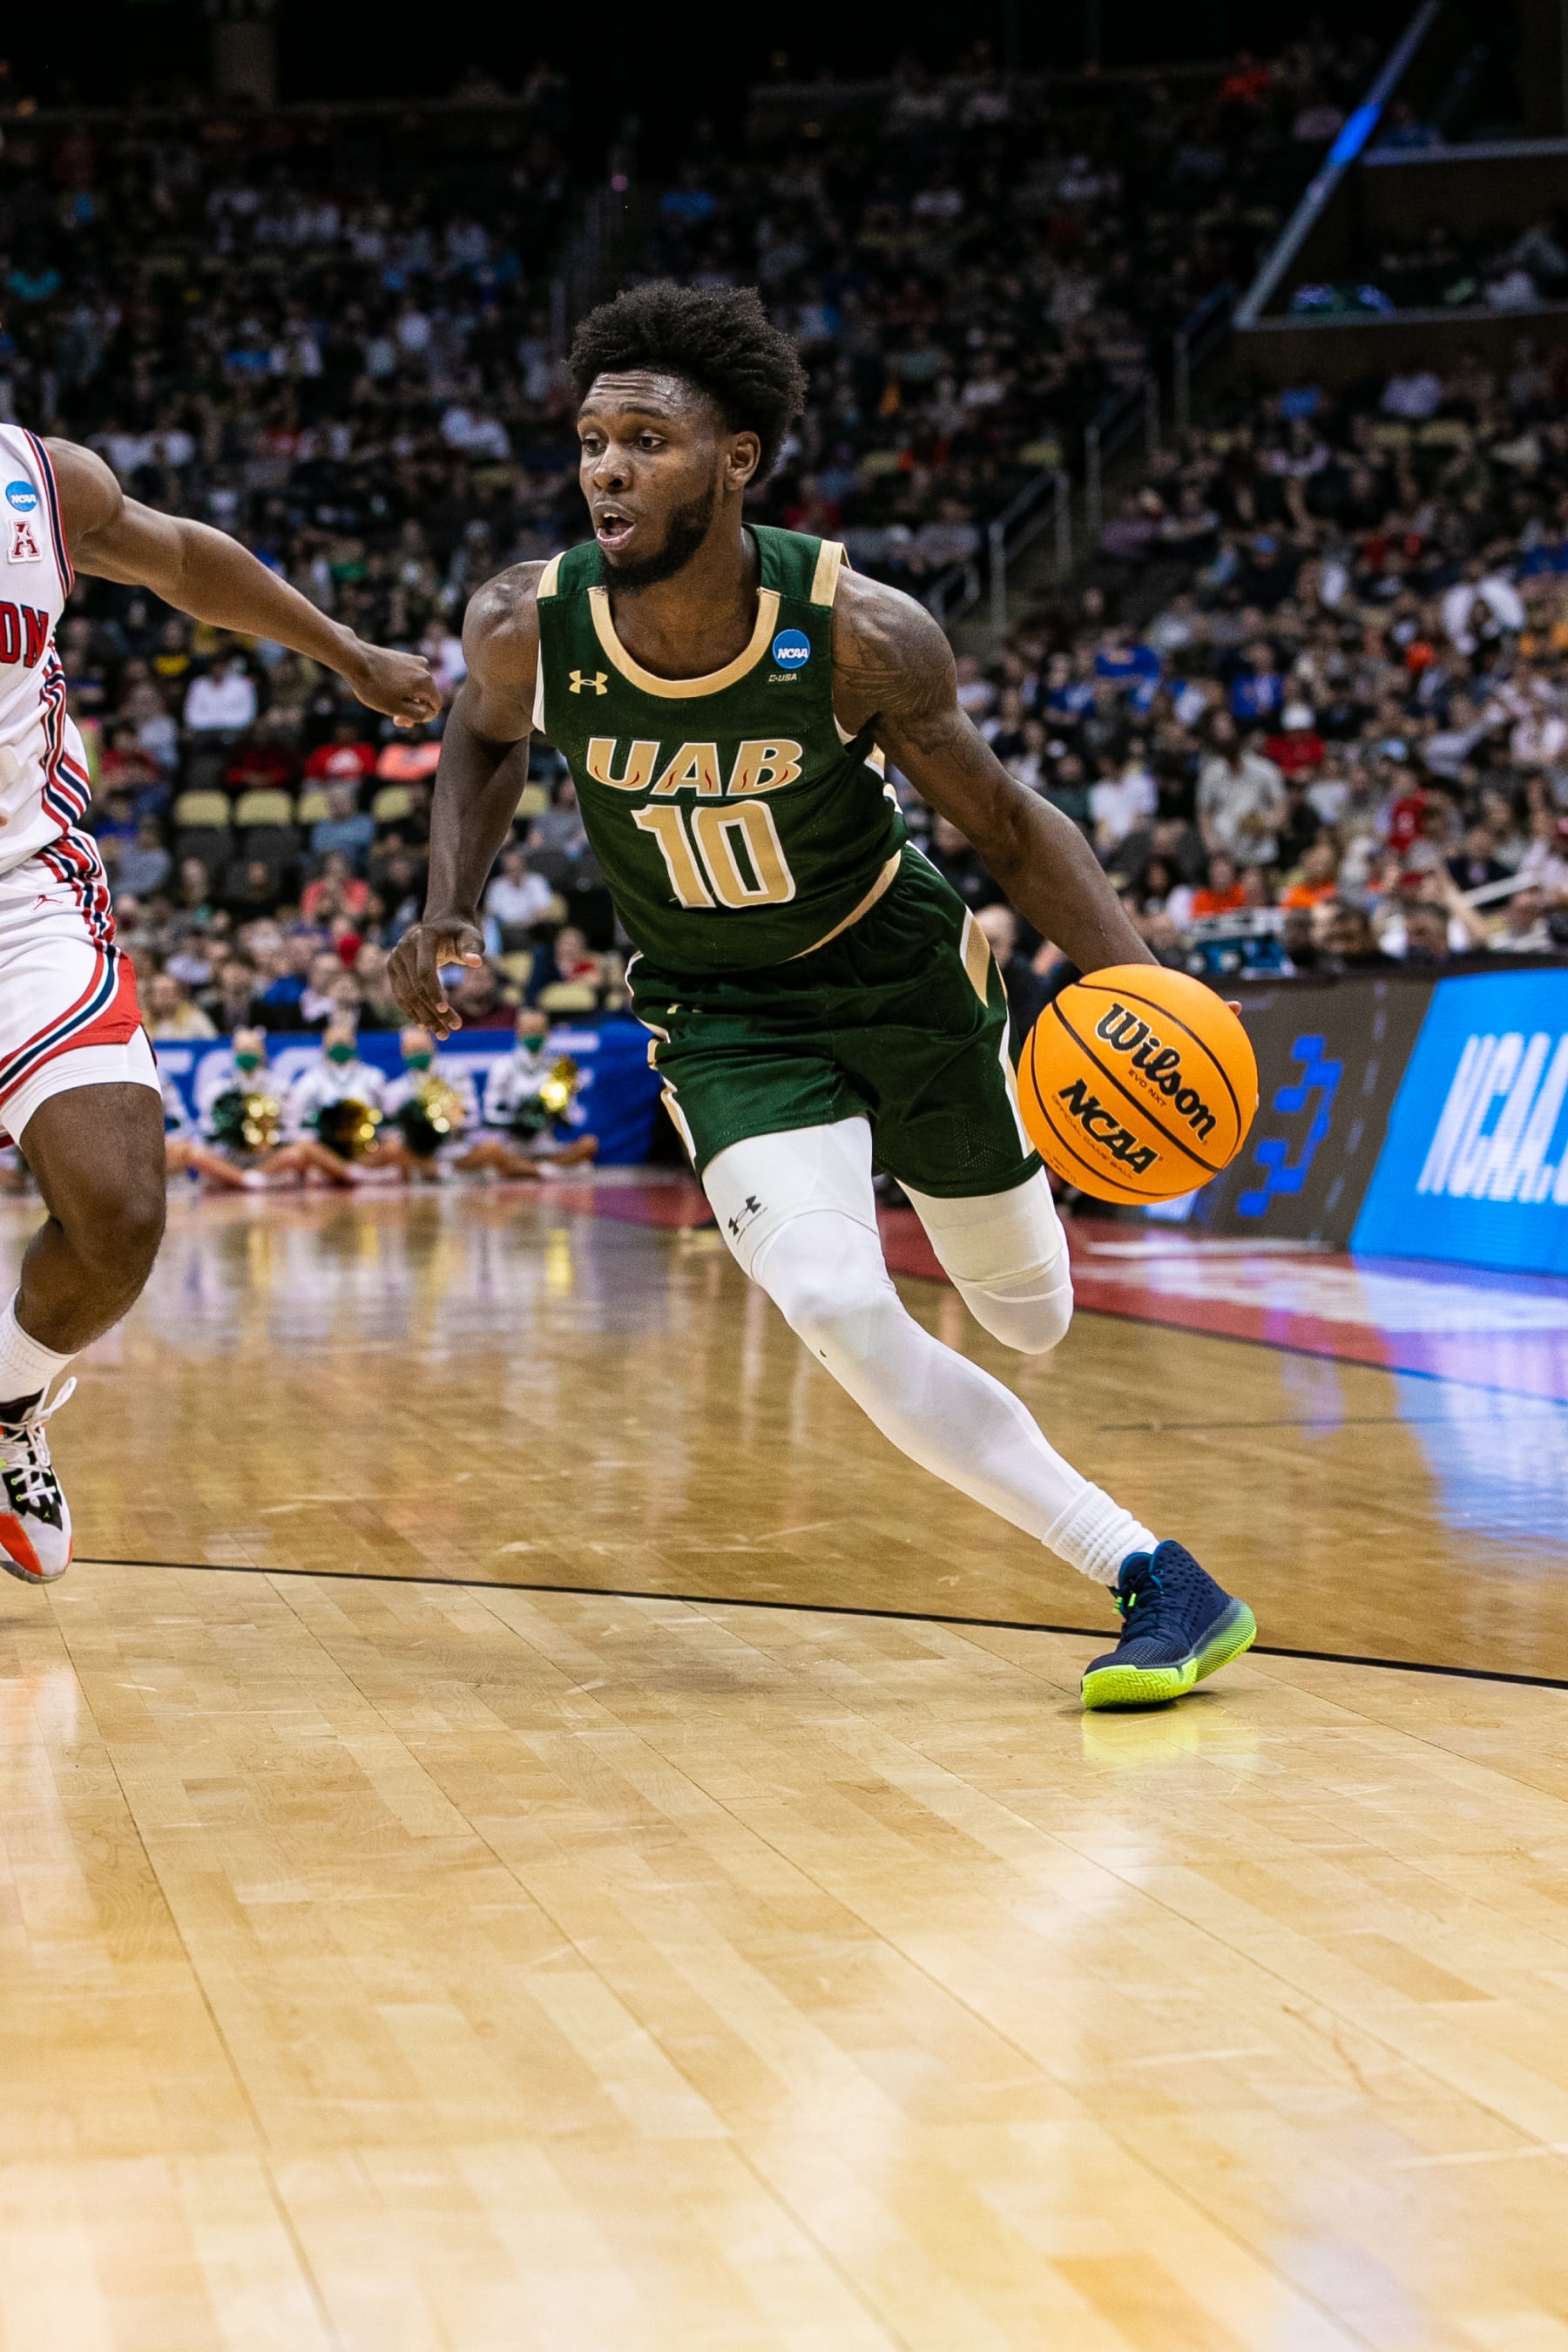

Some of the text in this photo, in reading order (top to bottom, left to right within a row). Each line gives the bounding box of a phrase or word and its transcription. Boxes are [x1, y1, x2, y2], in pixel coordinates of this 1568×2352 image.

[10, 494, 37, 504] NCAA
[12, 522, 41, 558] A
[768, 672, 797, 682] C-USA
[777, 647, 808, 659] NCAA
[586, 737, 803, 796] UAB
[630, 799, 796, 909] 10
[1096, 1003, 1217, 1142] Wilson
[1128, 1069, 1167, 1107] EVO NXT
[1058, 1078, 1159, 1175] NCAA
[1416, 1031, 1568, 1206] NCAA.
